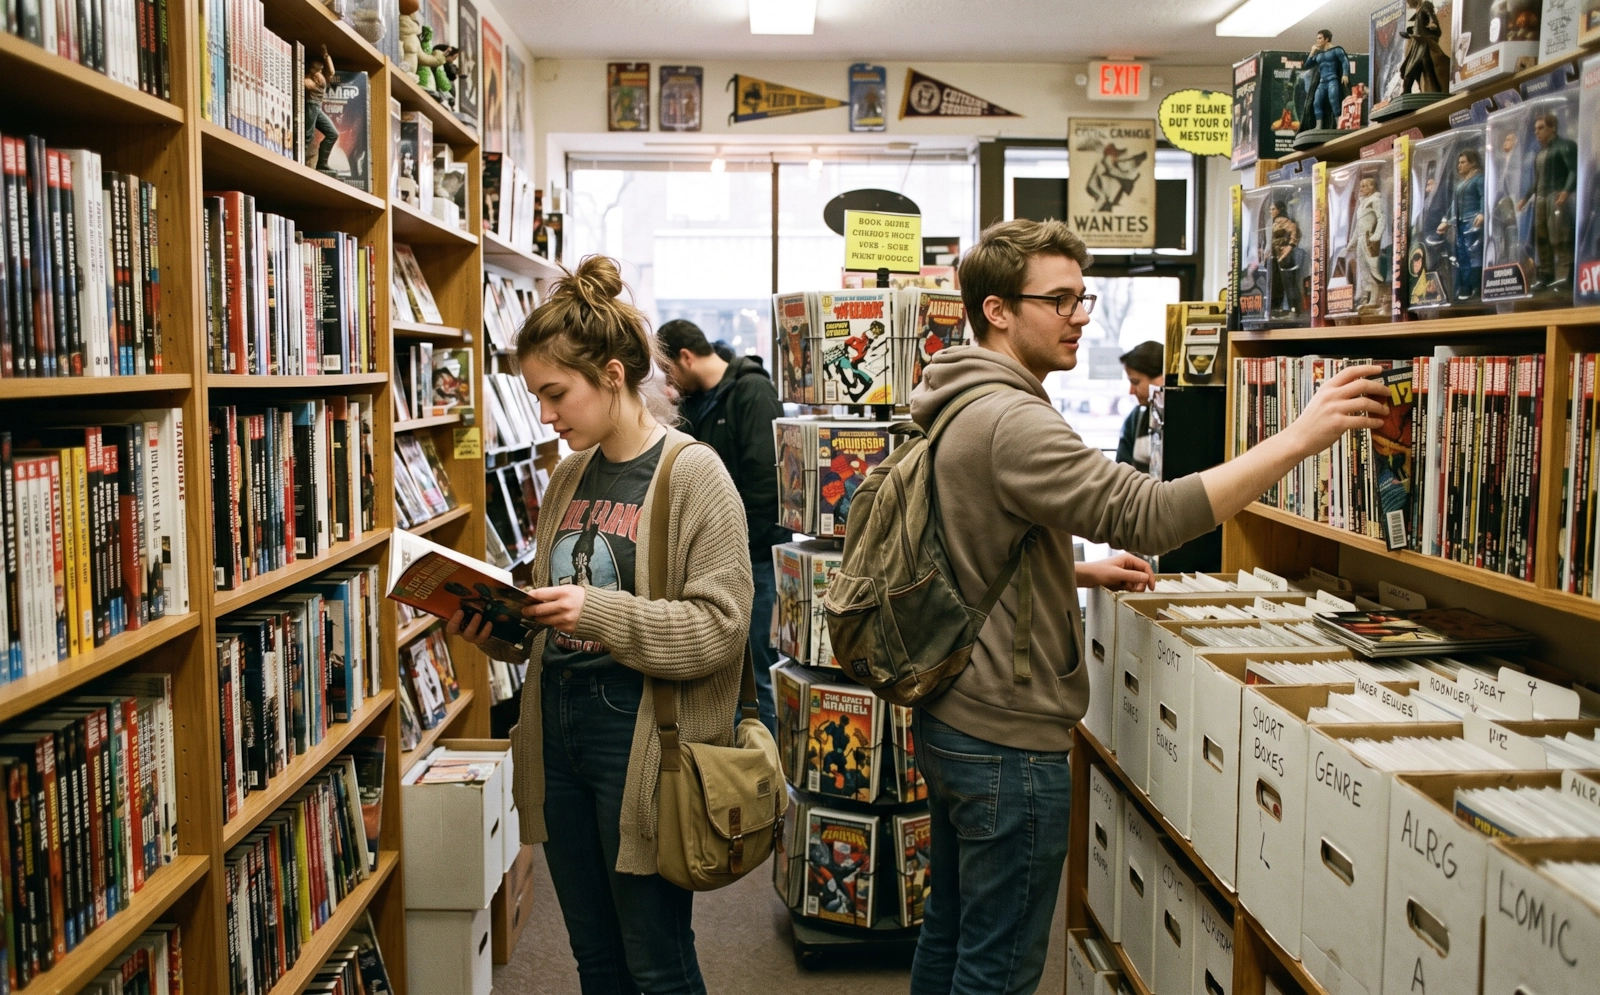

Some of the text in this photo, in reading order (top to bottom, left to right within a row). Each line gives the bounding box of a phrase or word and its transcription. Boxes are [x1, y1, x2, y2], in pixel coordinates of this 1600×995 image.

[1100, 65, 1143, 96] EXIT
[1193, 118, 1219, 128] YOUR
[859, 218, 882, 226] BOOK
[1073, 215, 1149, 232] WANTES
[1157, 640, 1181, 672] SHORT
[1252, 706, 1284, 742] SHORT
[1254, 737, 1284, 778] BOXES
[1315, 751, 1362, 808] GENRE
